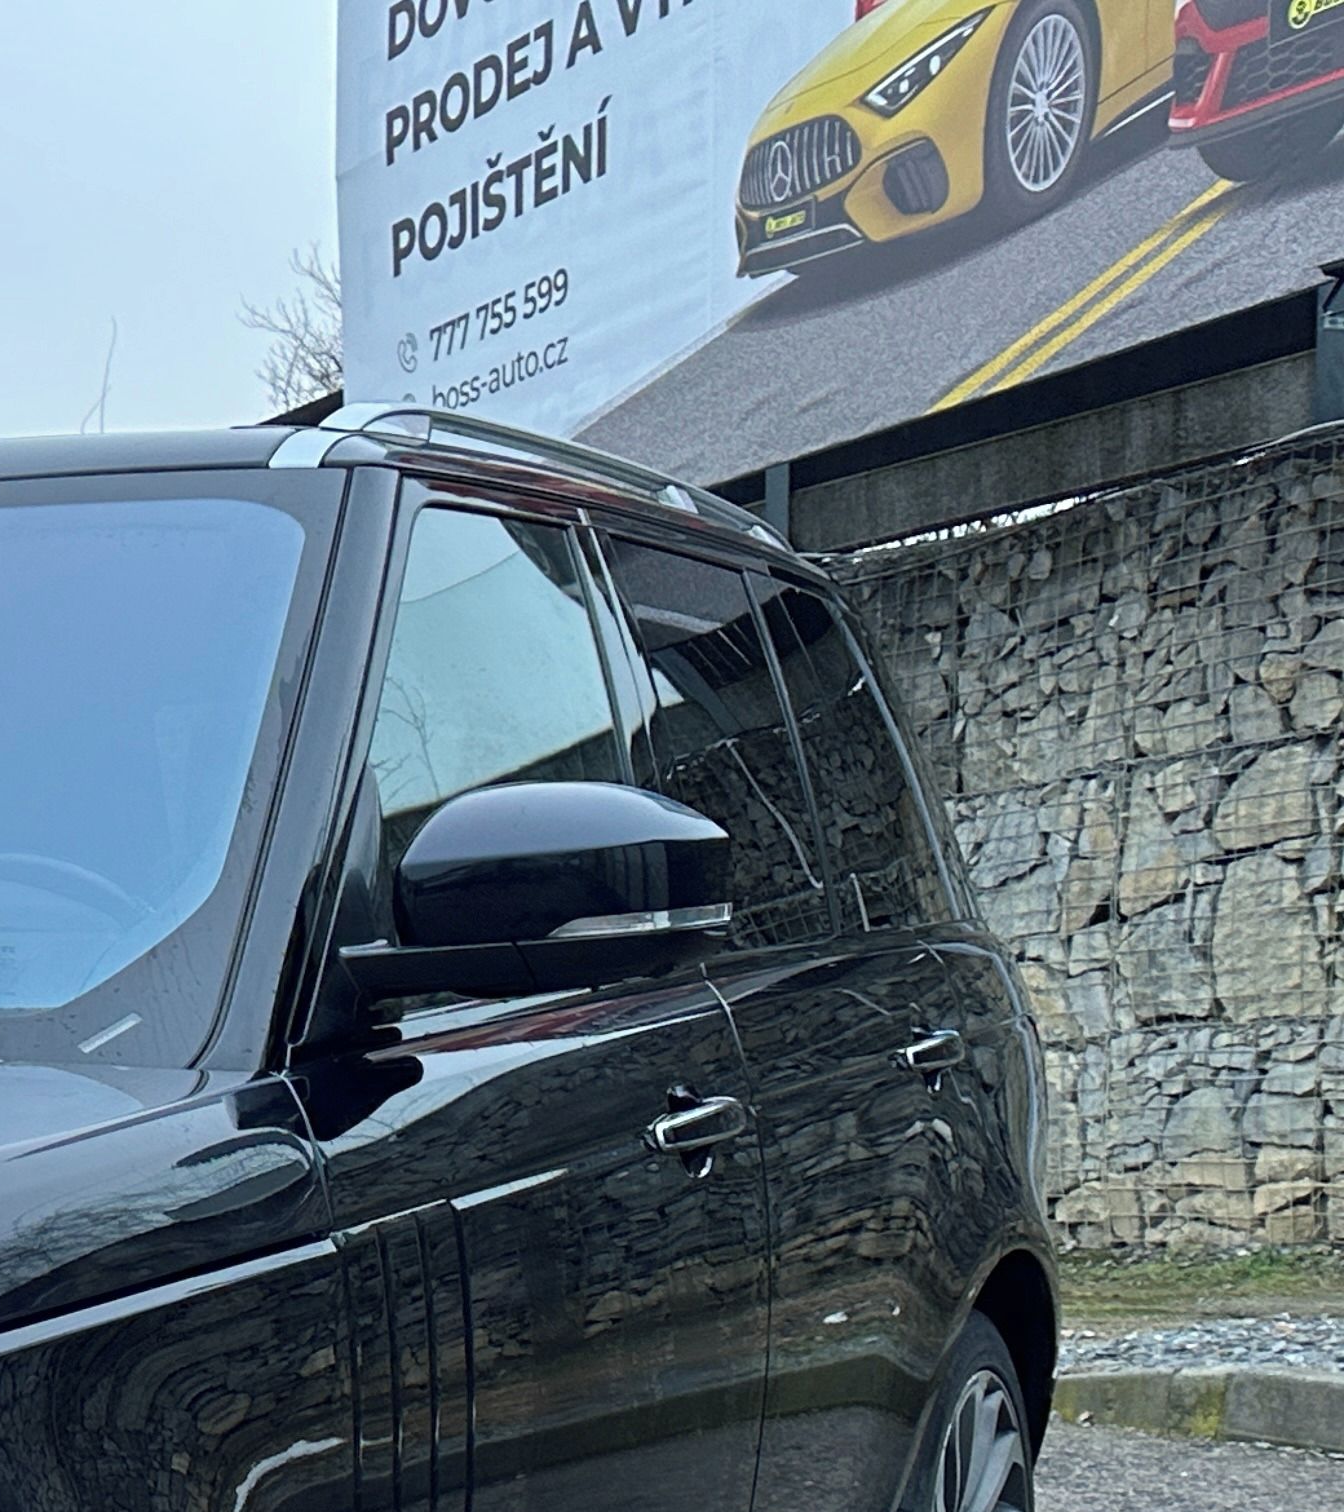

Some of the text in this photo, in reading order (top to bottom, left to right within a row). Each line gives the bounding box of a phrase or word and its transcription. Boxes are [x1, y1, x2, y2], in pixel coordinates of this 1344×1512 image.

[385, 0, 603, 167] PRODEJ A
[391, 94, 613, 278] POJIŠTĚNÍ
[429, 267, 569, 362] 777 755 599
[431, 335, 569, 410] boss-auto.cz
